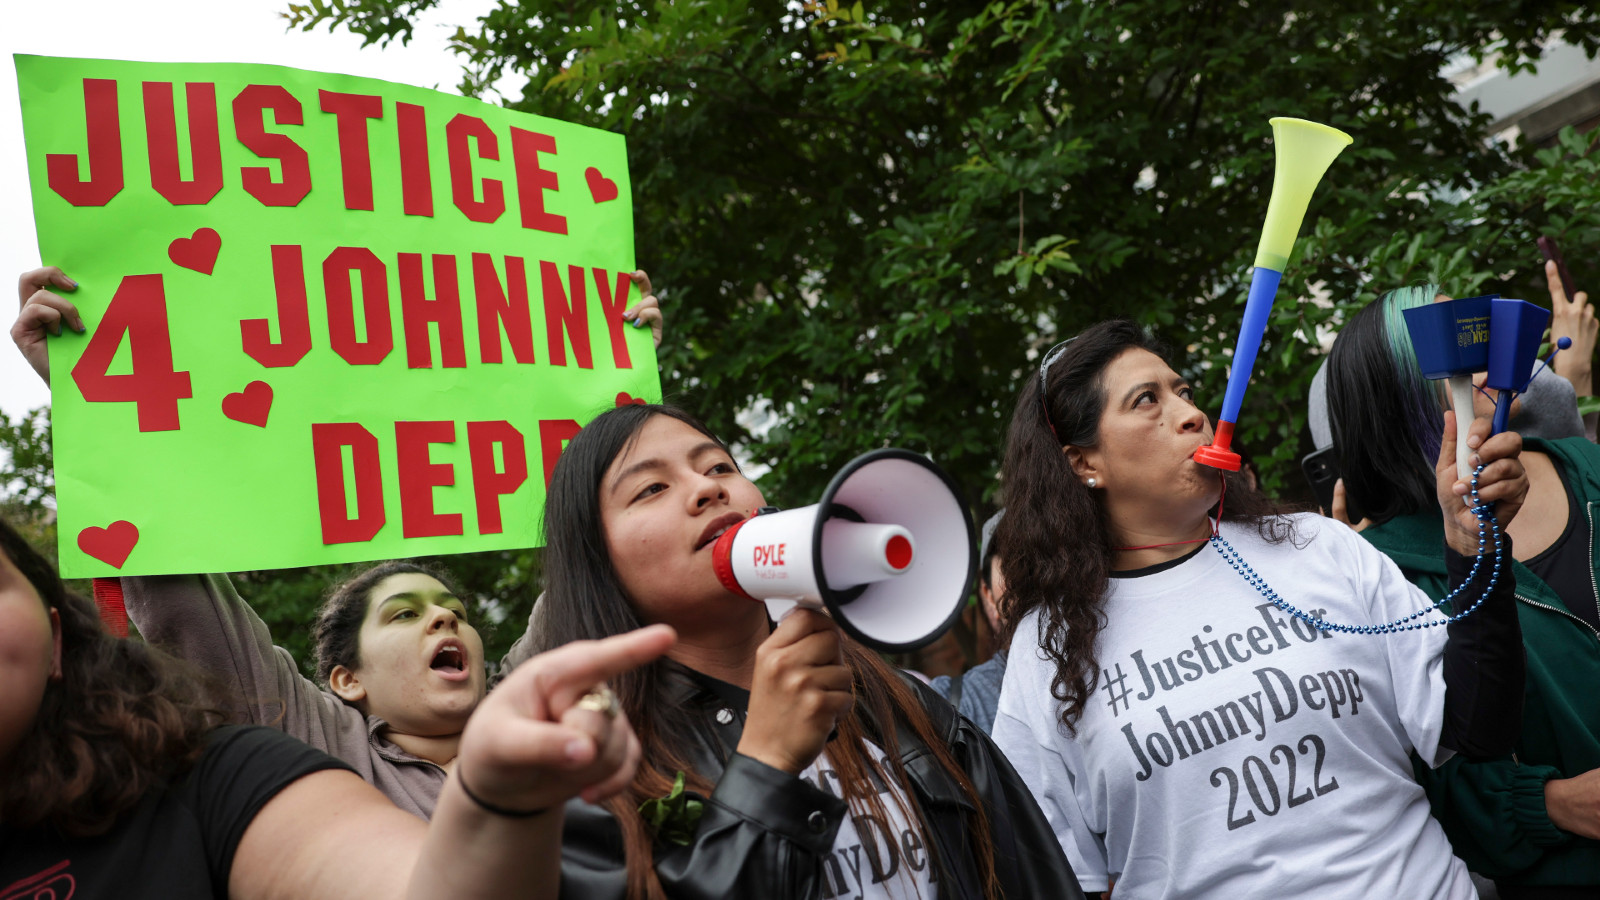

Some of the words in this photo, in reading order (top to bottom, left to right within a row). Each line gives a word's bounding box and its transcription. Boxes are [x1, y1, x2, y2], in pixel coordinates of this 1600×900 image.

[46, 78, 569, 236] JUSTICE
[71, 273, 193, 433] 4
[240, 244, 633, 369] JOHNNY
[753, 543, 787, 567] PYLE
[1101, 601, 1333, 717] #JusticeFor
[1120, 667, 1364, 782] JohnnyDepp
[1209, 734, 1340, 831] 2022
